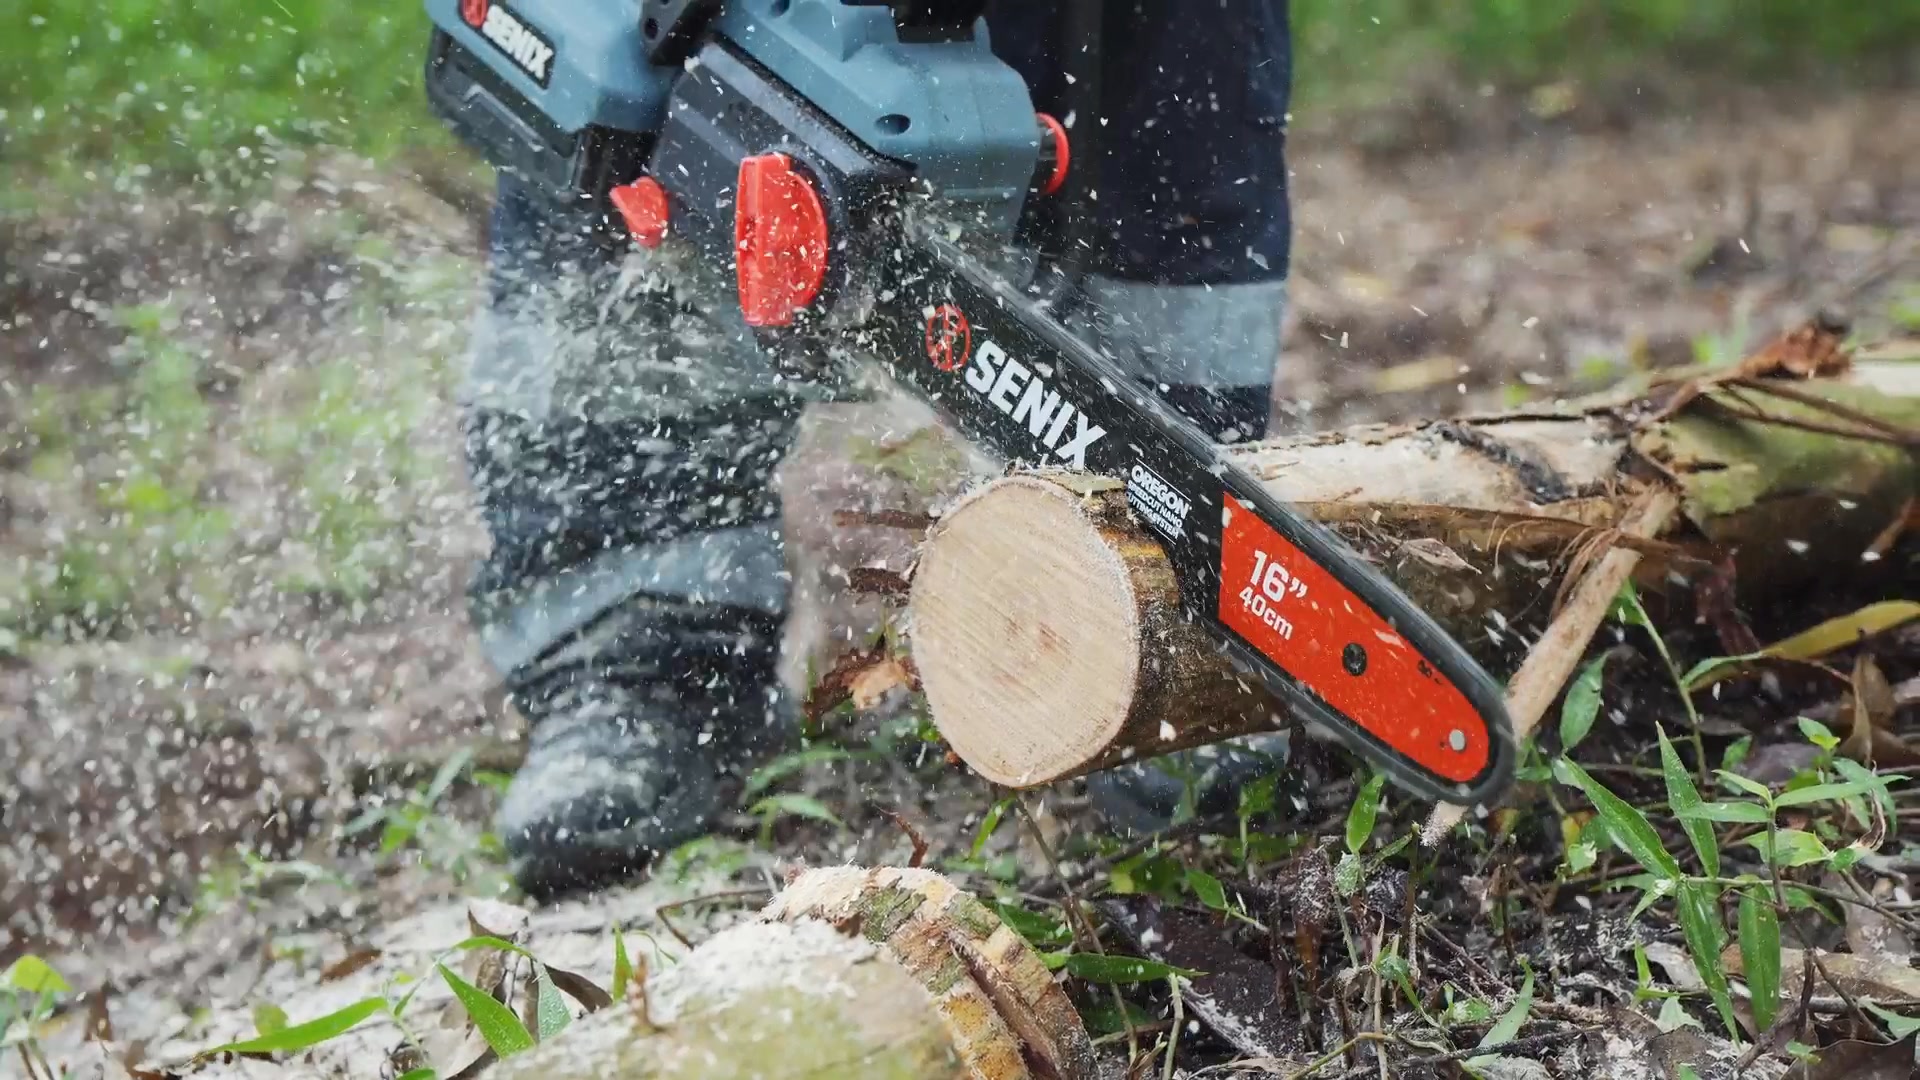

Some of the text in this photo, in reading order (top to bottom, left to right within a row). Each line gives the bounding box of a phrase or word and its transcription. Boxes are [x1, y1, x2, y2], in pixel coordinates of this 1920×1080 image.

[482, 4, 554, 80] SENIX
[964, 339, 1107, 471] SENIX
[1131, 464, 1190, 520] OREGON
[1160, 508, 1183, 528] NANO
[1153, 512, 1180, 540] SYSTEM
[1239, 586, 1294, 641] 40cm
